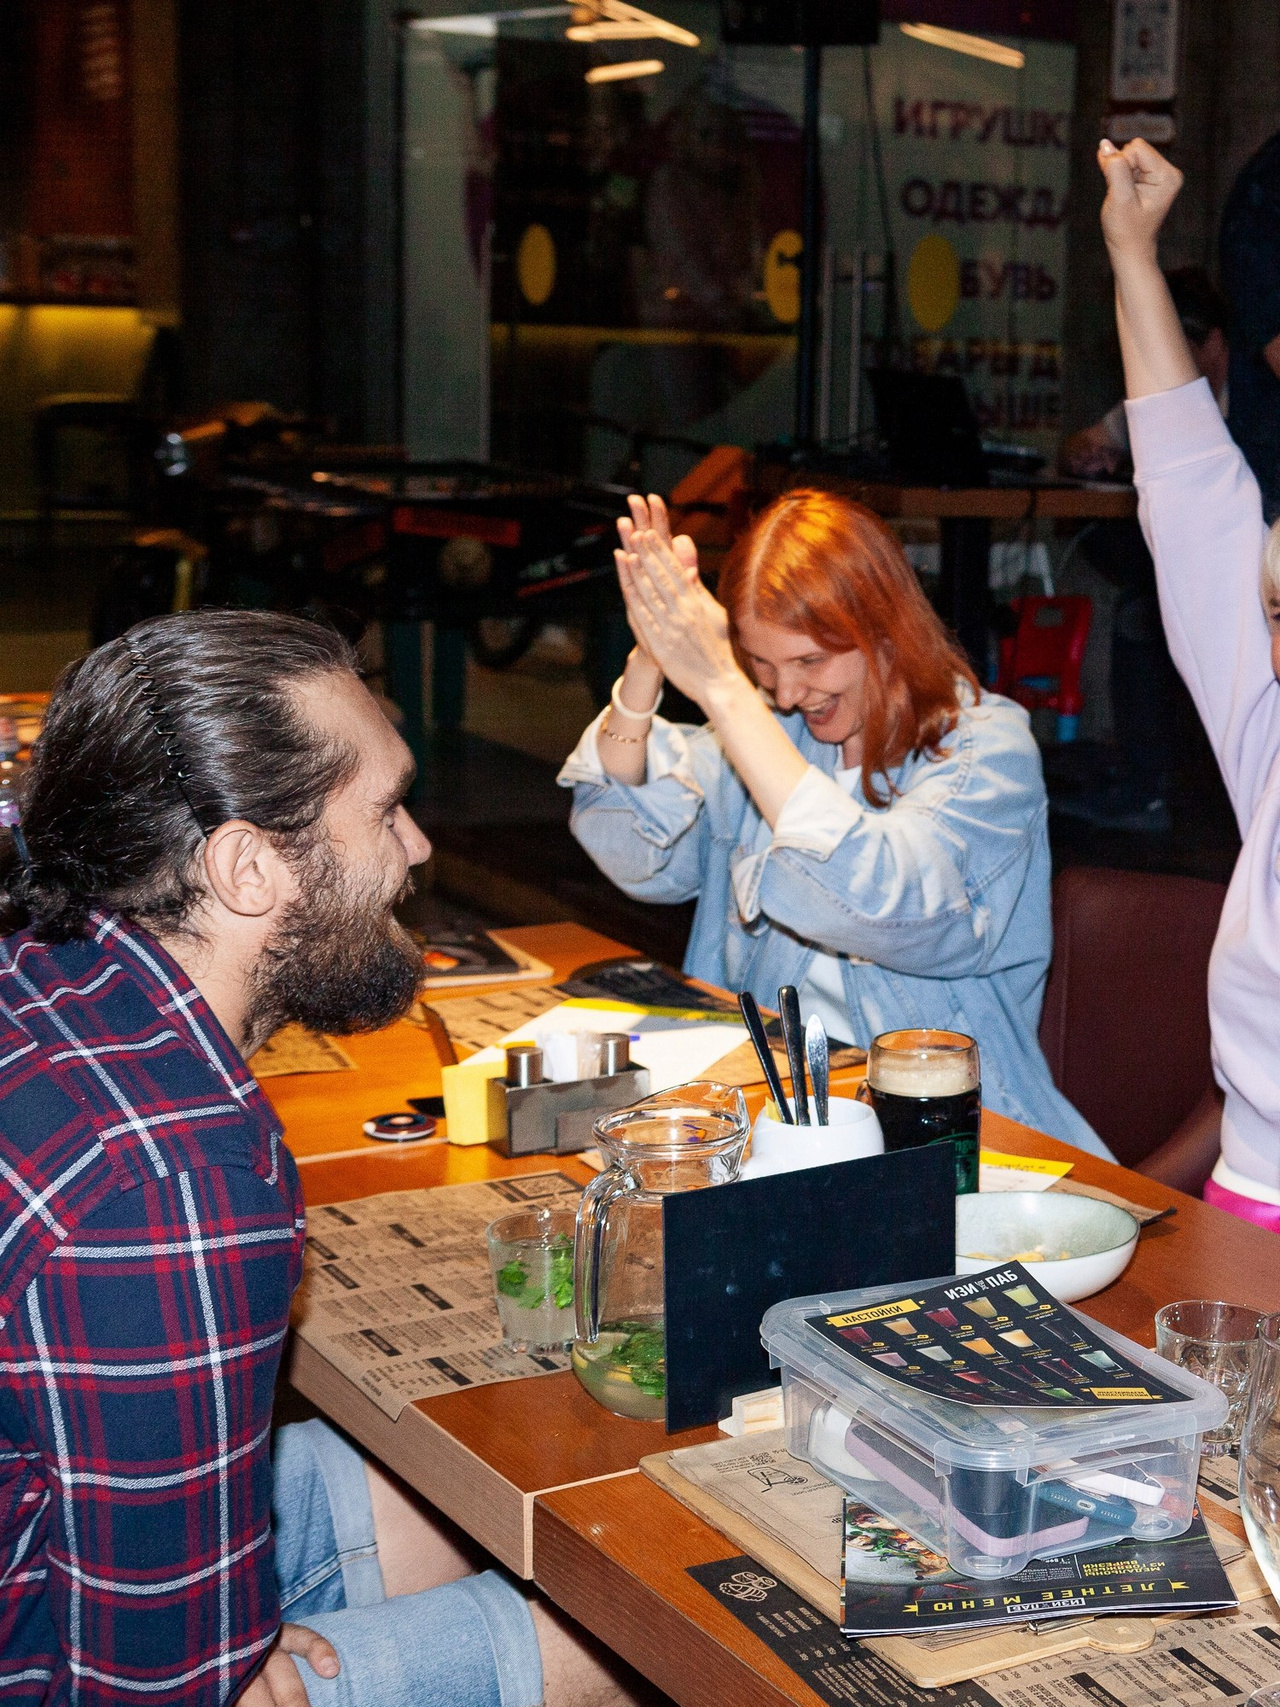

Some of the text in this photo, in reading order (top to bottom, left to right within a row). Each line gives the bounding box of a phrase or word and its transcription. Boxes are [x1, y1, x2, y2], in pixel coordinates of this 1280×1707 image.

[894, 100, 1070, 148] ИГРУШК
[901, 178, 1067, 229] ОДЕЖД
[960, 260, 1058, 301] БУВЬ
[944, 1269, 1019, 1301] ИЗИ ПАБ
[841, 1304, 904, 1324] НАСТОЙКИ
[1085, 1566, 1160, 1577] МЕДАЛЬОНЫ
[933, 1582, 1155, 1611] ЛЕТНЕЕ МЕНЮ
